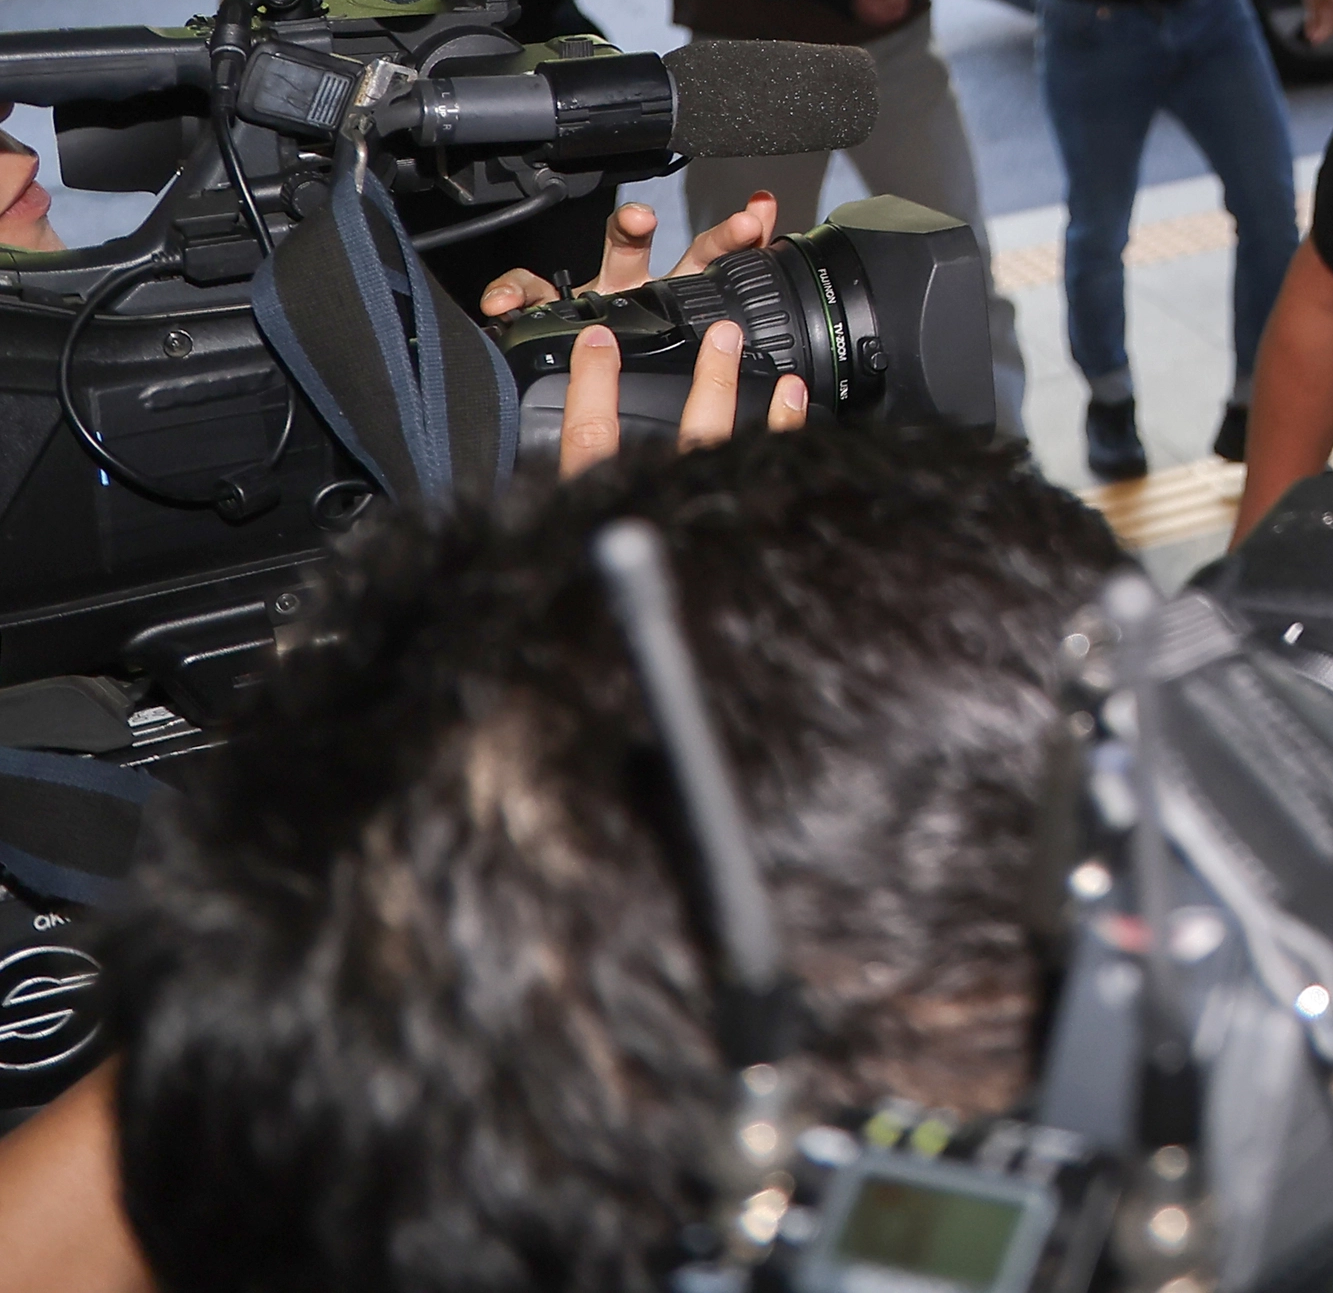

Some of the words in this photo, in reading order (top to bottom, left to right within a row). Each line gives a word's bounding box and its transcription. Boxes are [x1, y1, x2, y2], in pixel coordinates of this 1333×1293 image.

[438, 105, 447, 117] UP
[818, 268, 836, 304] FUJINON
[834, 322, 847, 362] TV-ZOOM
[839, 379, 848, 400] LENS
